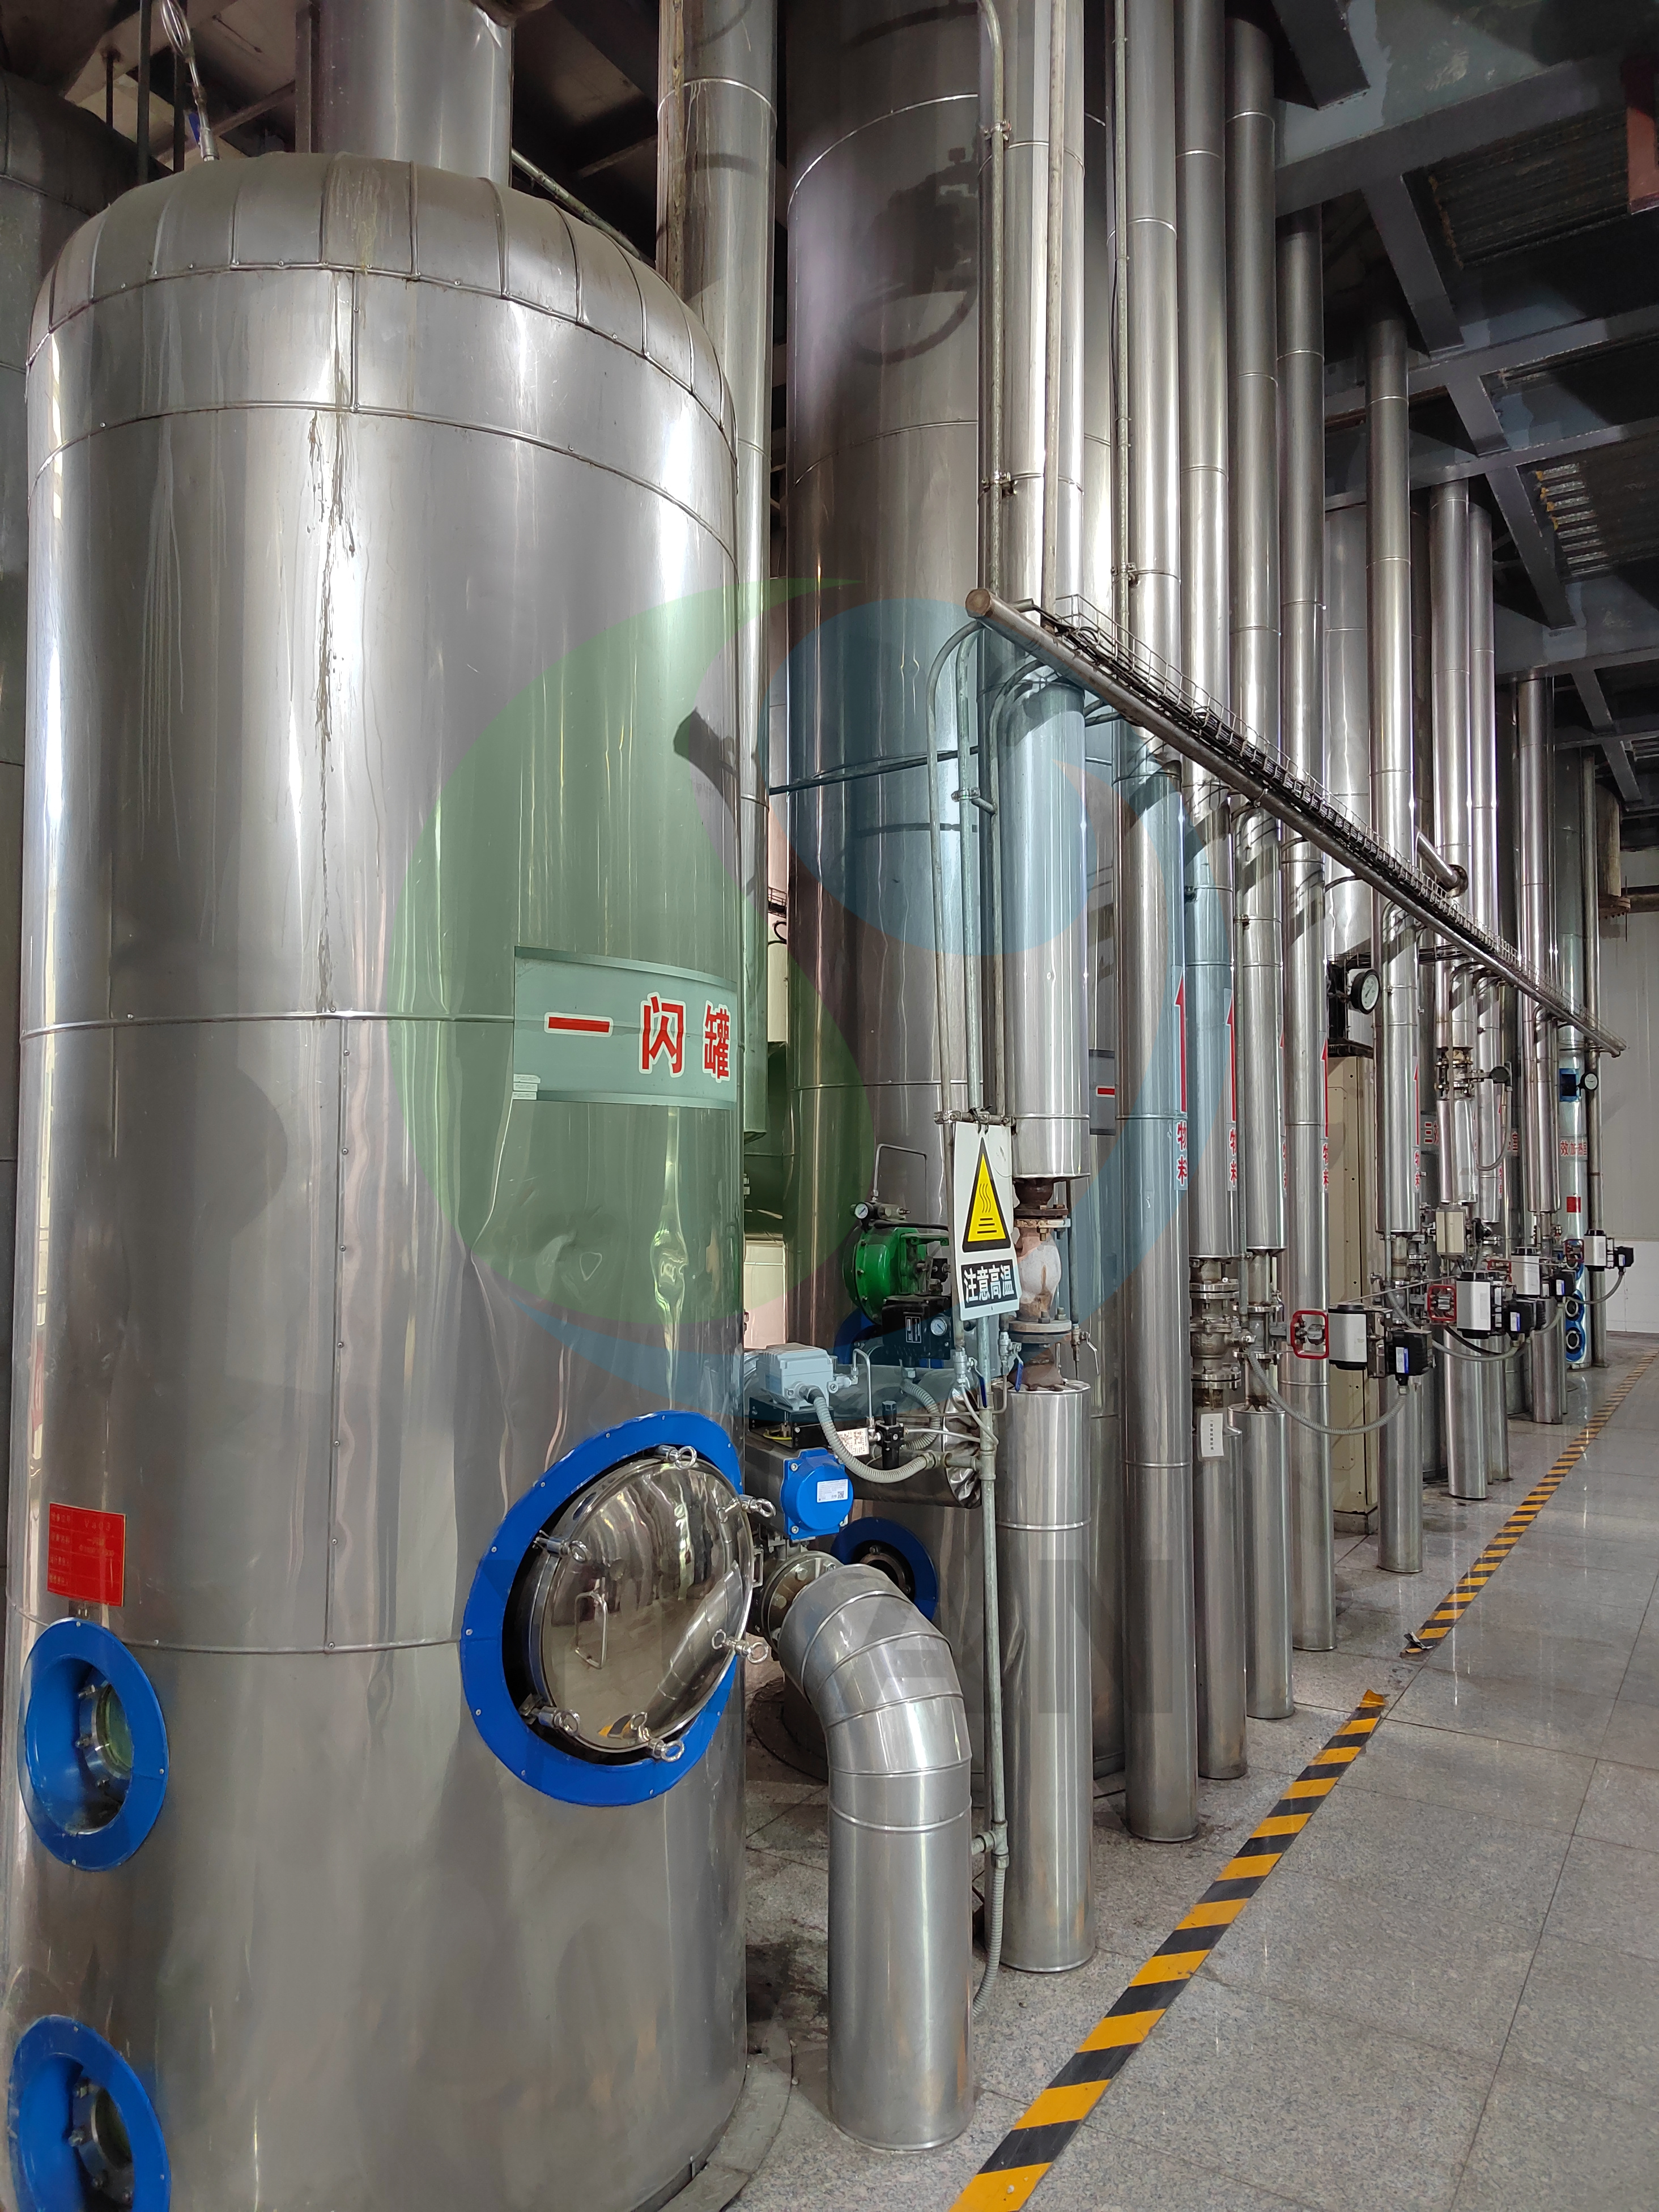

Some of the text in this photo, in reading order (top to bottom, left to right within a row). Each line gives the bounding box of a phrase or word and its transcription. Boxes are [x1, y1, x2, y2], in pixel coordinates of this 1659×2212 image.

[546, 993, 730, 1082] 一闪罐
[964, 1264, 1014, 1303] 注意高温
